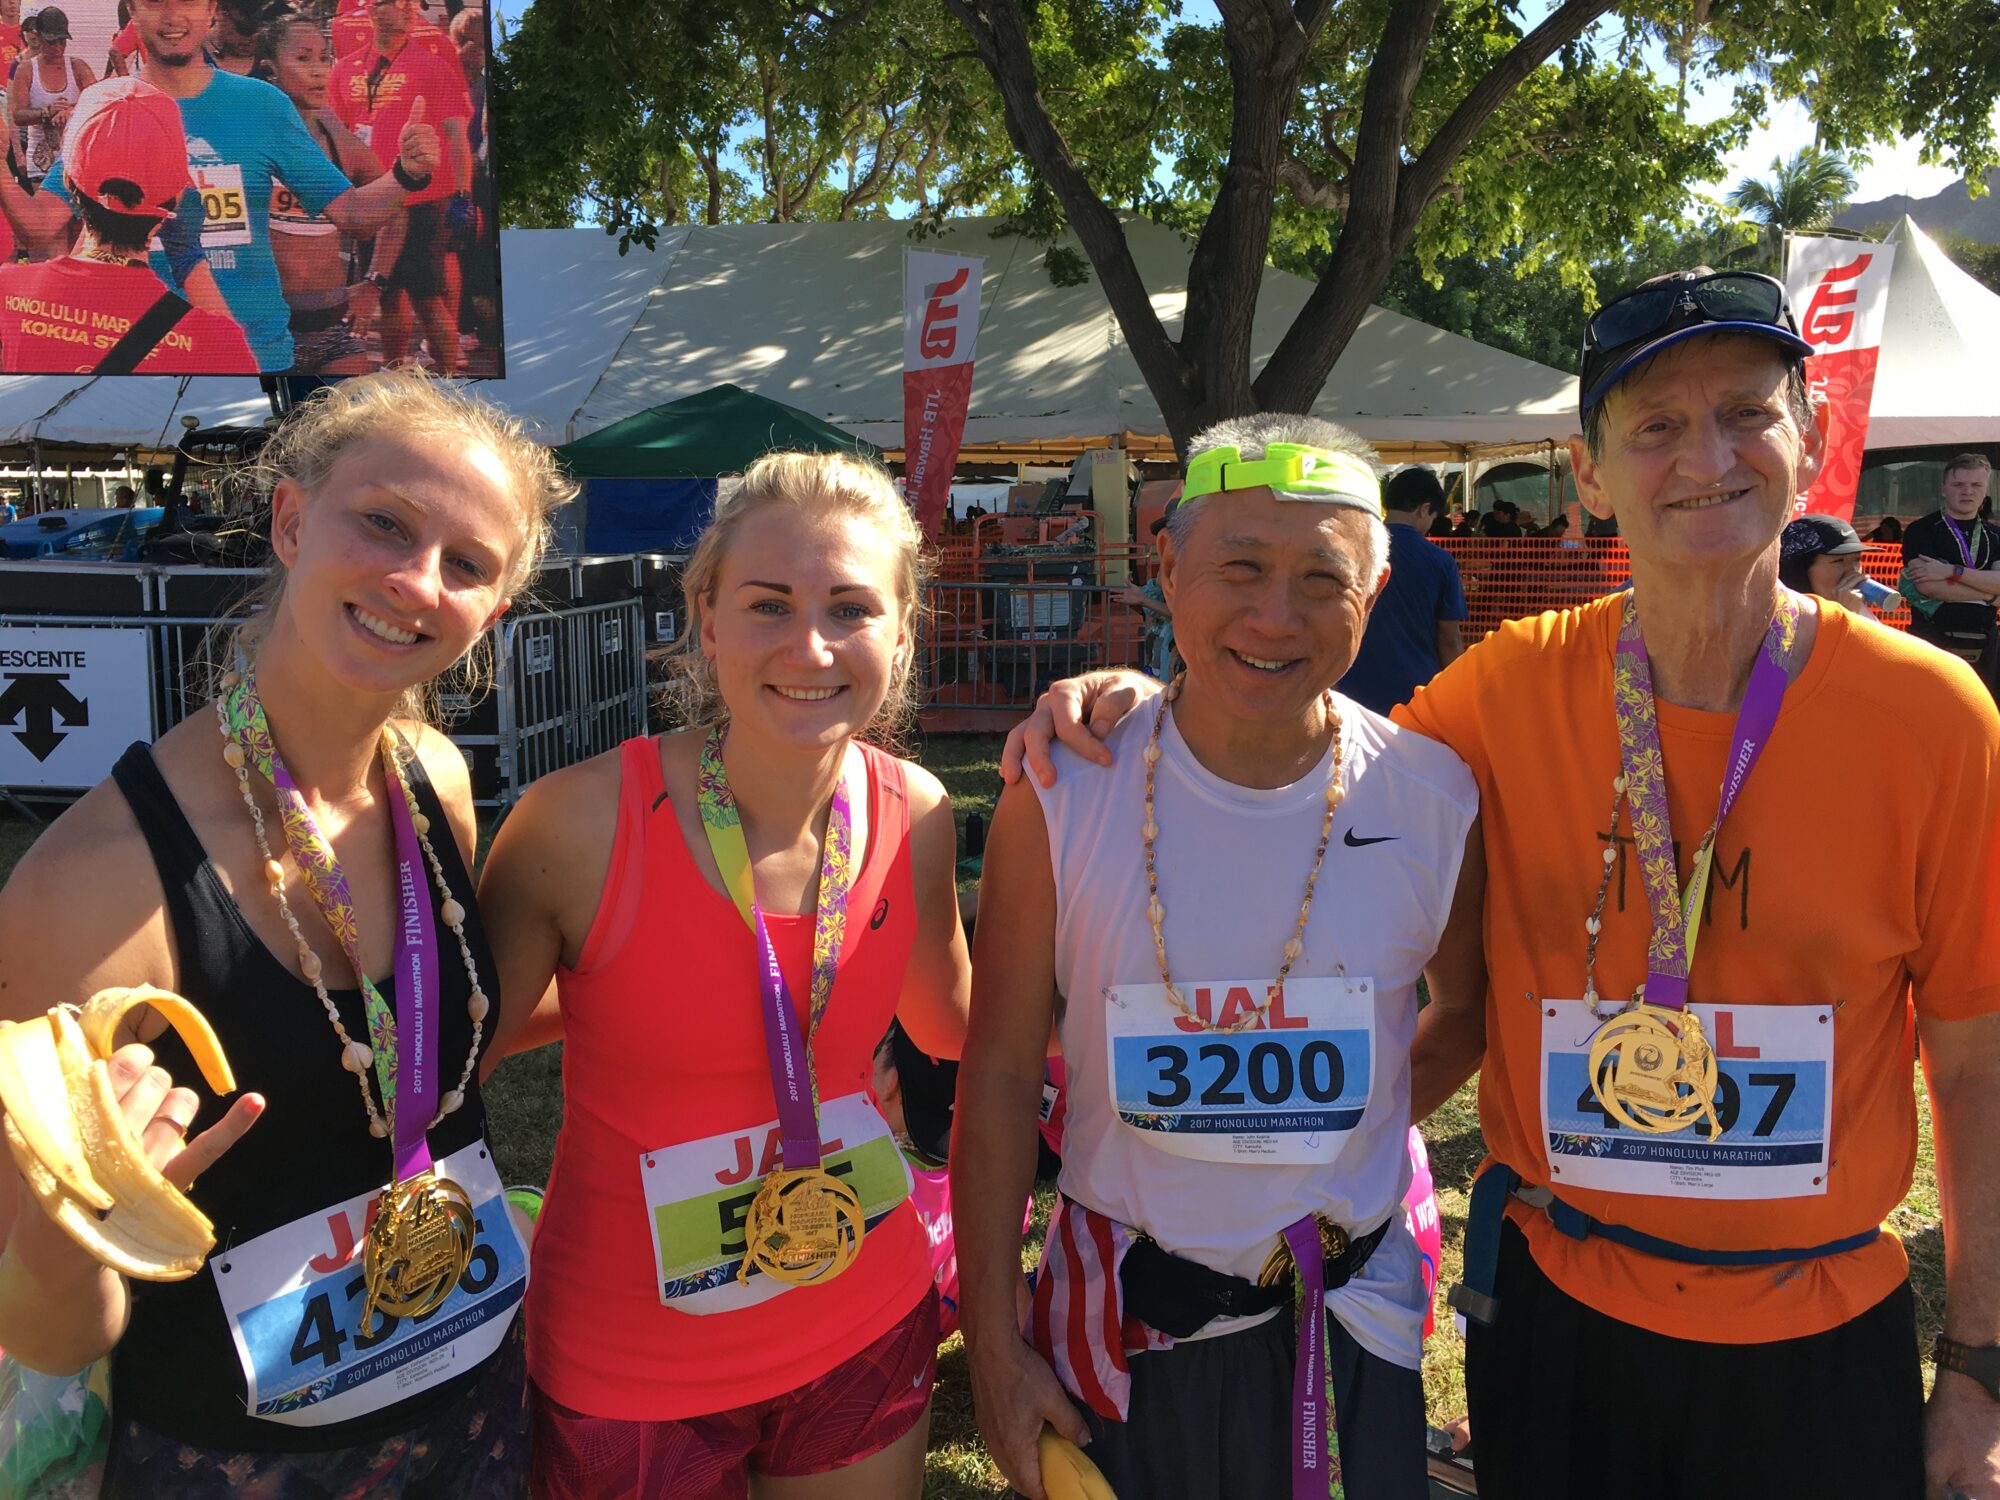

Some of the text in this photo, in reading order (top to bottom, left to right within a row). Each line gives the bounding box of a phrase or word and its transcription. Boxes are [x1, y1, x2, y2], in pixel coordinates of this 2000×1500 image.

[5, 295, 87, 325] HONOLULU
[20, 319, 90, 345] KOKUA
[400, 859, 423, 1094] 2017 HONOLULU MARATHON FINISHER
[773, 984, 787, 1031] MARATHON
[1173, 986, 1308, 1032] JAL
[781, 1033, 795, 1079] HONOLULU
[1146, 1040, 1345, 1107] 3200
[788, 1080, 799, 1102] 2017
[1577, 1064, 1796, 1138] 497
[1190, 1116, 1324, 1129] 2017 HONOLULU MARATHON
[1623, 1144, 1771, 1161] 2017 HONOLULU MARATHON
[290, 1219, 499, 1368] 436
[346, 1364, 372, 1385] 2017
[375, 1338, 431, 1370] HONOLULU
[433, 1307, 486, 1343] MARATHON
[1306, 1353, 1315, 1396] MARATHON
[1303, 1401, 1317, 1470] FINISHER
